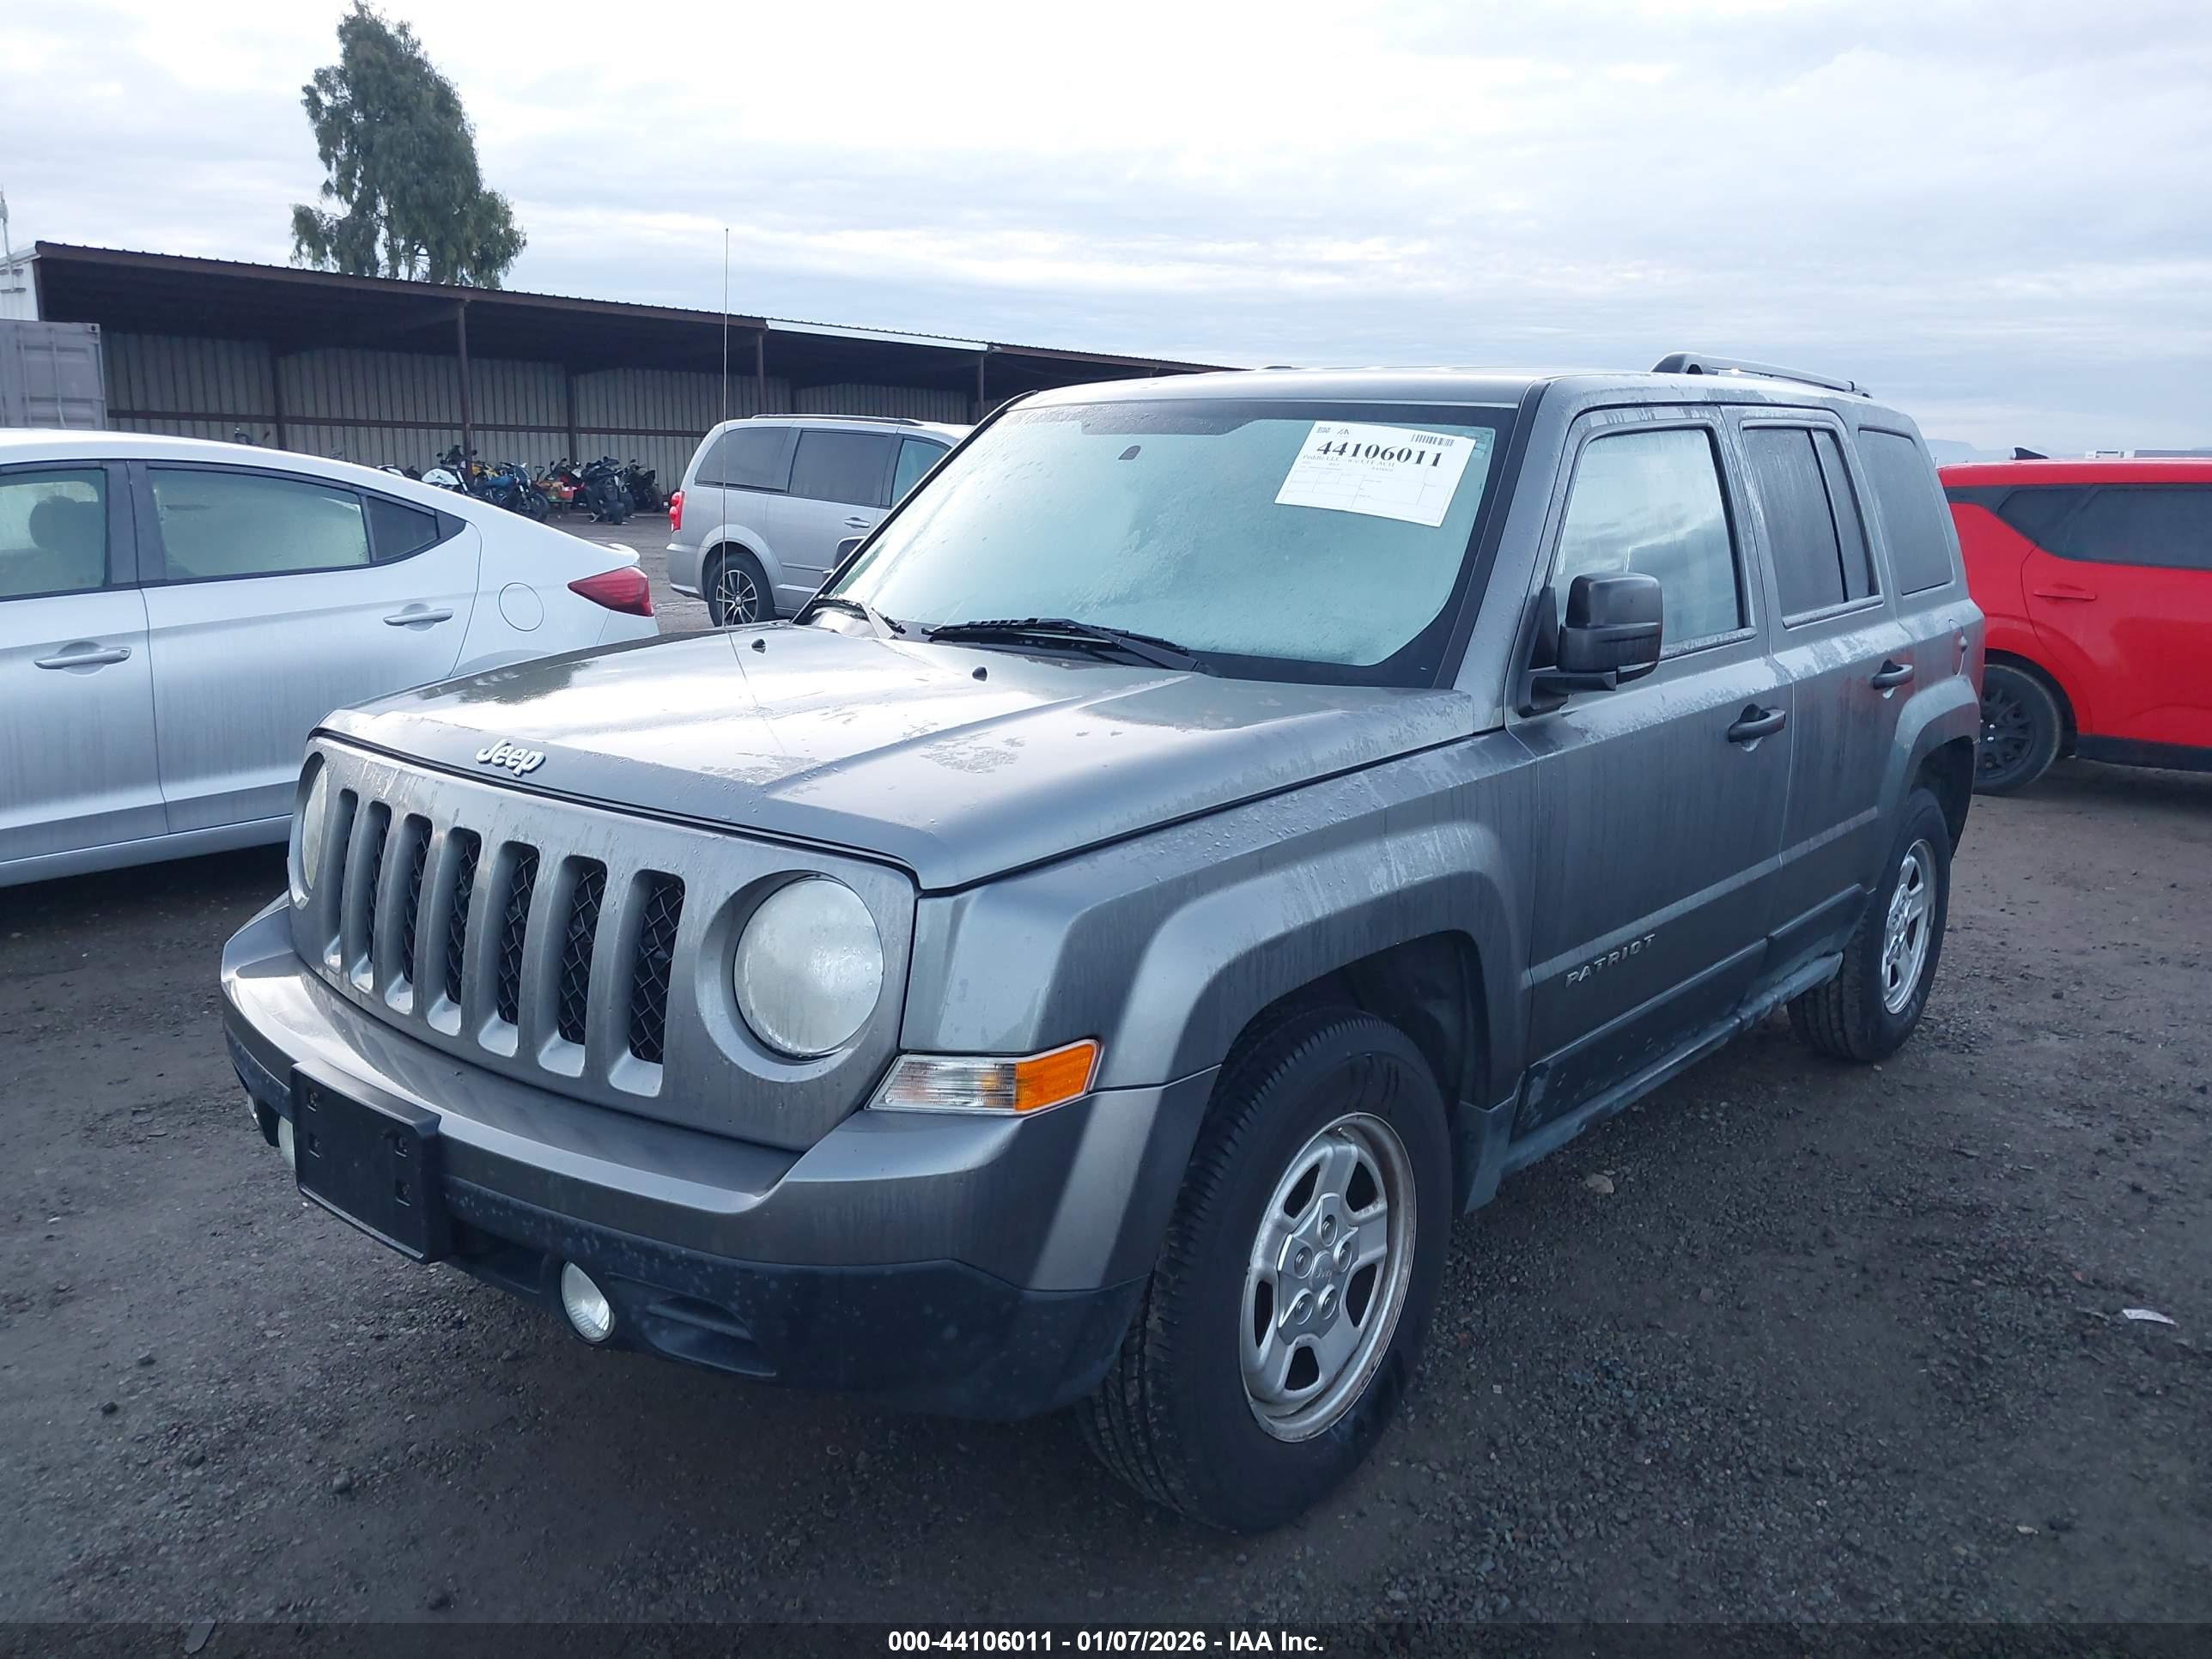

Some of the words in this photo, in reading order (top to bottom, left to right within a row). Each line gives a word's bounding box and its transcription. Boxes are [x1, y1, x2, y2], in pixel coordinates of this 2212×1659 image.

[1316, 441, 1443, 468] 44106011
[476, 738, 545, 776] Jeep
[1565, 933, 1656, 988] PATRIOT
